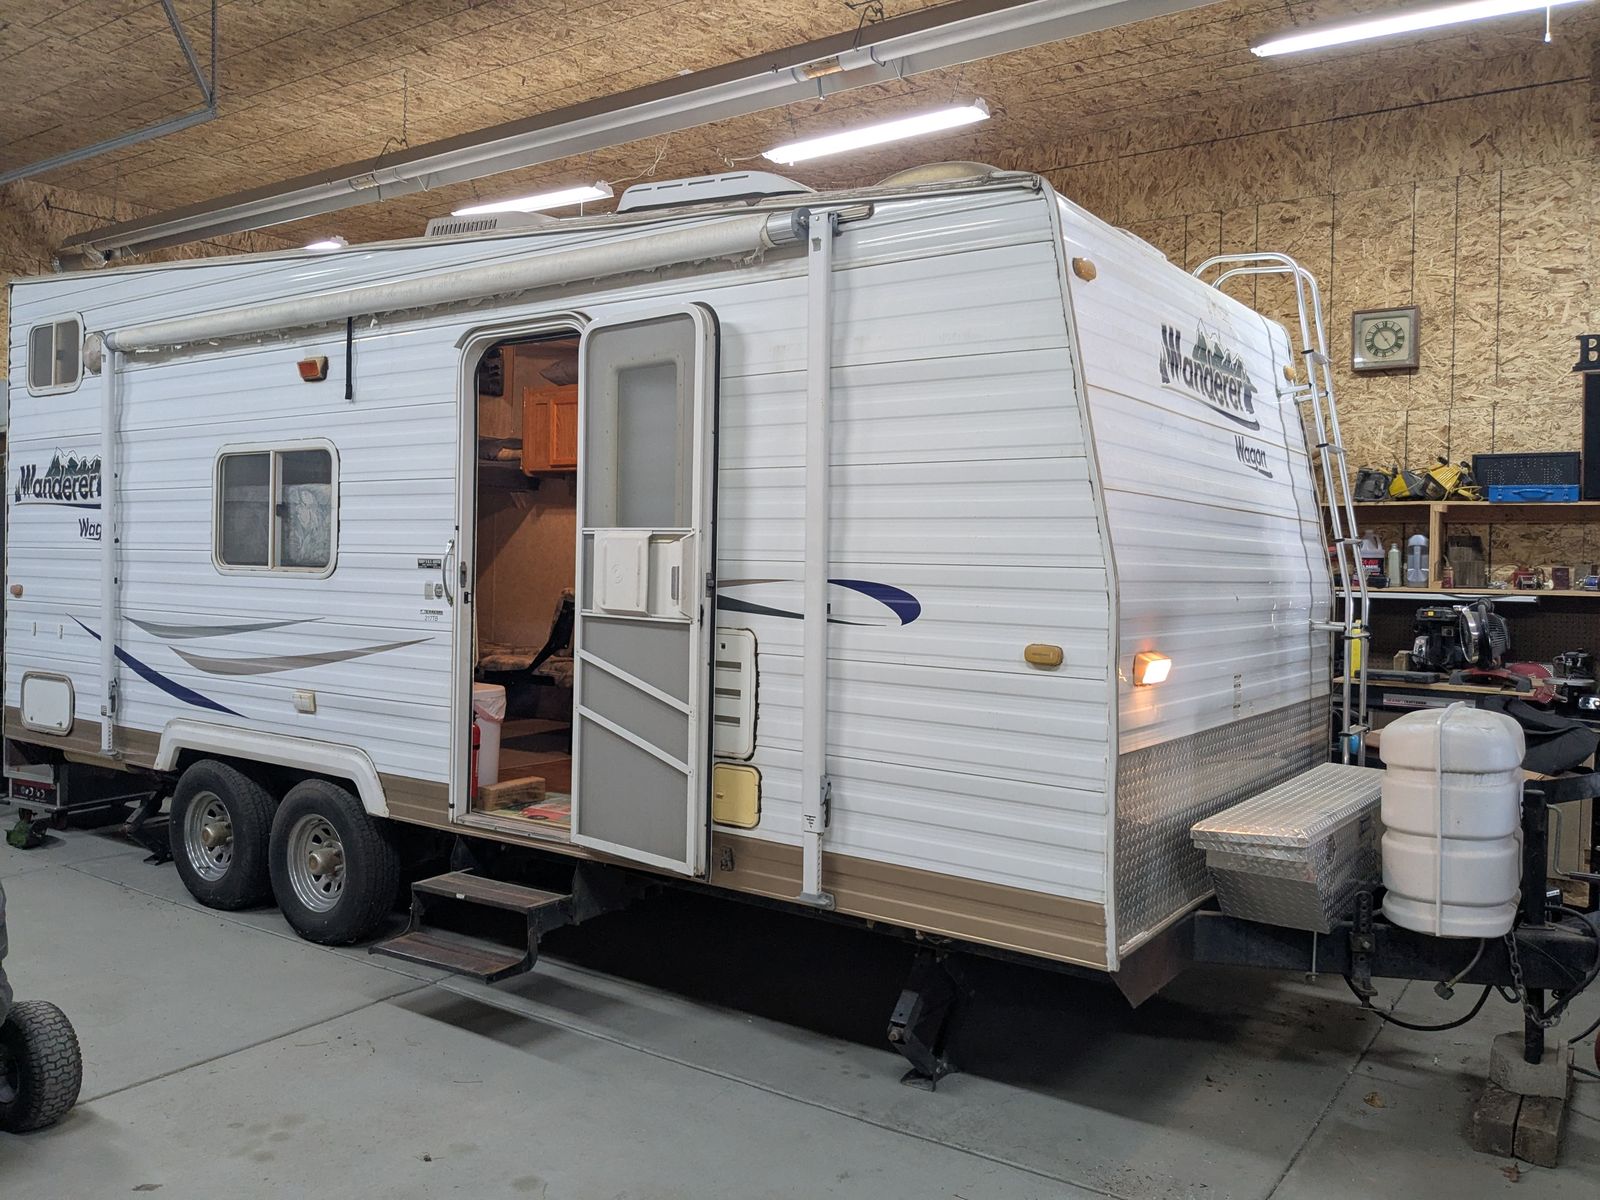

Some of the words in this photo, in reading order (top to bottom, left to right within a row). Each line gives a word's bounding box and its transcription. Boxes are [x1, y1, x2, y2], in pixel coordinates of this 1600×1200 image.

[1160, 325, 1247, 412] Wanderer
[1234, 434, 1268, 470] Wagon
[18, 464, 100, 501] Wanderer
[78, 517, 102, 538] Wag
